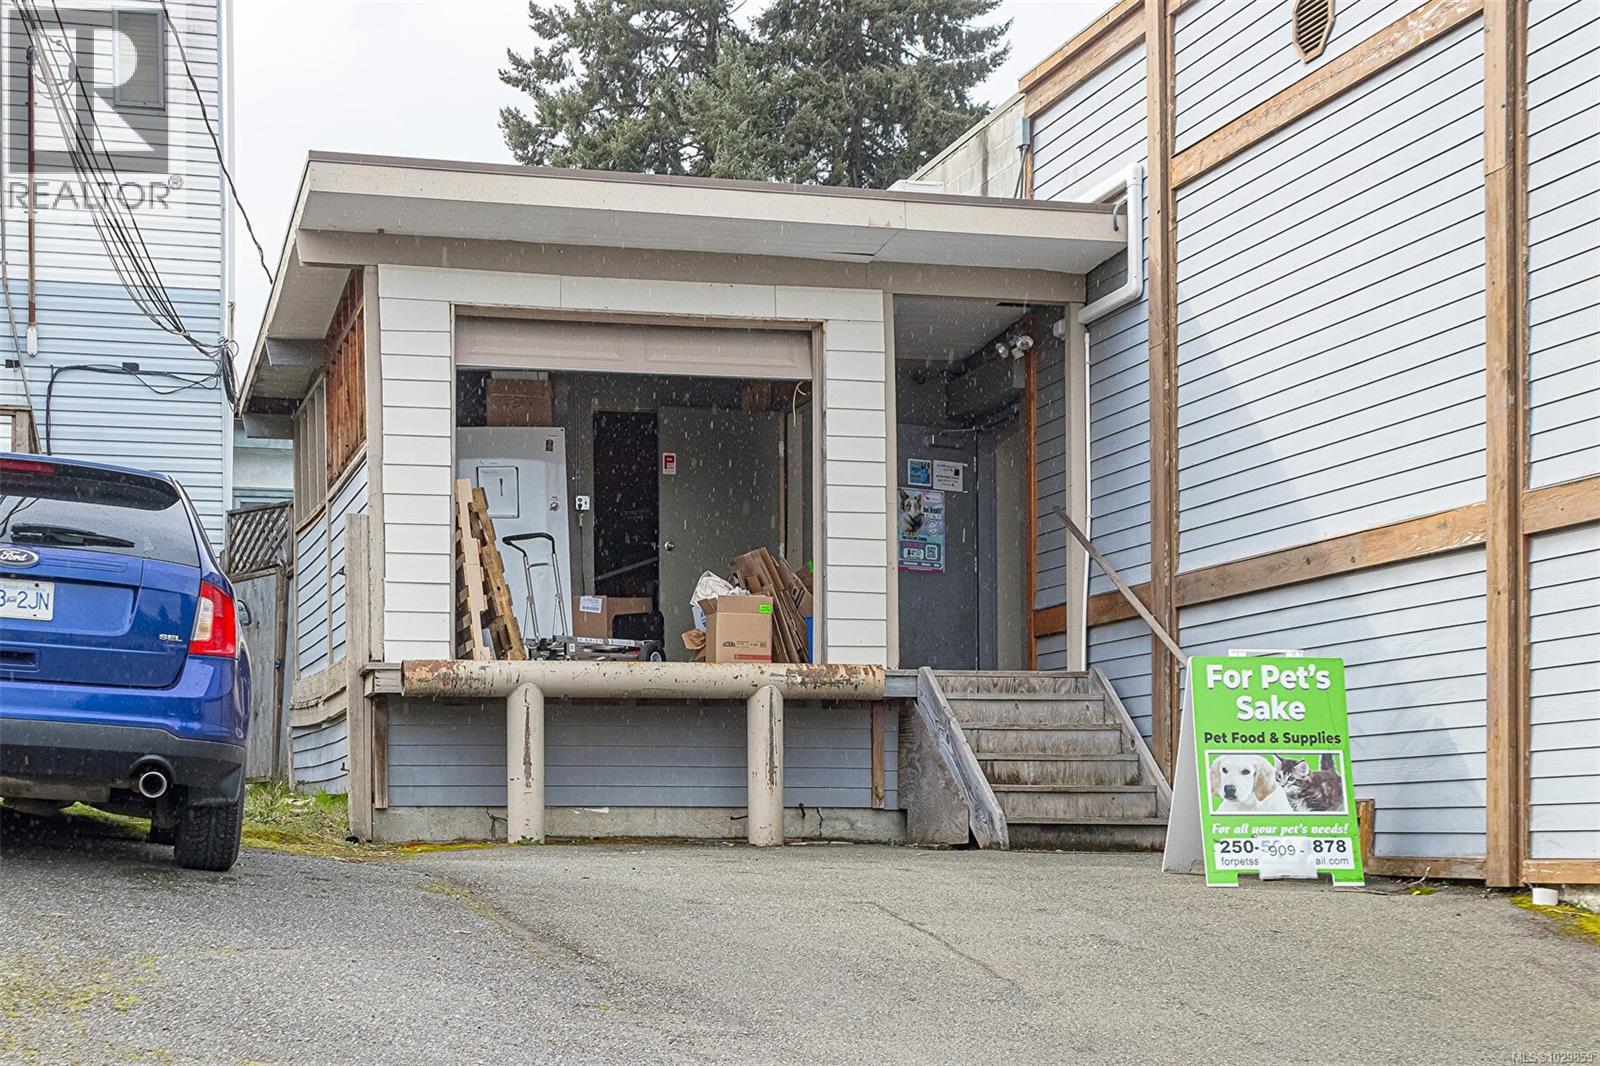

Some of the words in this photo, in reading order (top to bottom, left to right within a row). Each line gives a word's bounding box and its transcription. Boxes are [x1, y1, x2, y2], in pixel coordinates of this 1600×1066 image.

[0, 550, 28, 562] Ford
[158, 633, 183, 642] SEL
[1206, 664, 1253, 690] For
[1260, 663, 1332, 690] Pet's
[1236, 694, 1307, 721] Sake
[1204, 731, 1228, 744] Pet
[1231, 732, 1265, 744] Food
[1270, 732, 1279, 744] &
[1283, 732, 1342, 746] Supplies
[1212, 823, 1230, 834] For
[1233, 823, 1249, 834] all
[1252, 825, 1277, 836] your
[1280, 823, 1308, 836] pet's
[1312, 823, 1349, 834] needs!
[1268, 845, 1296, 857] 909
[1312, 839, 1347, 853] 878
